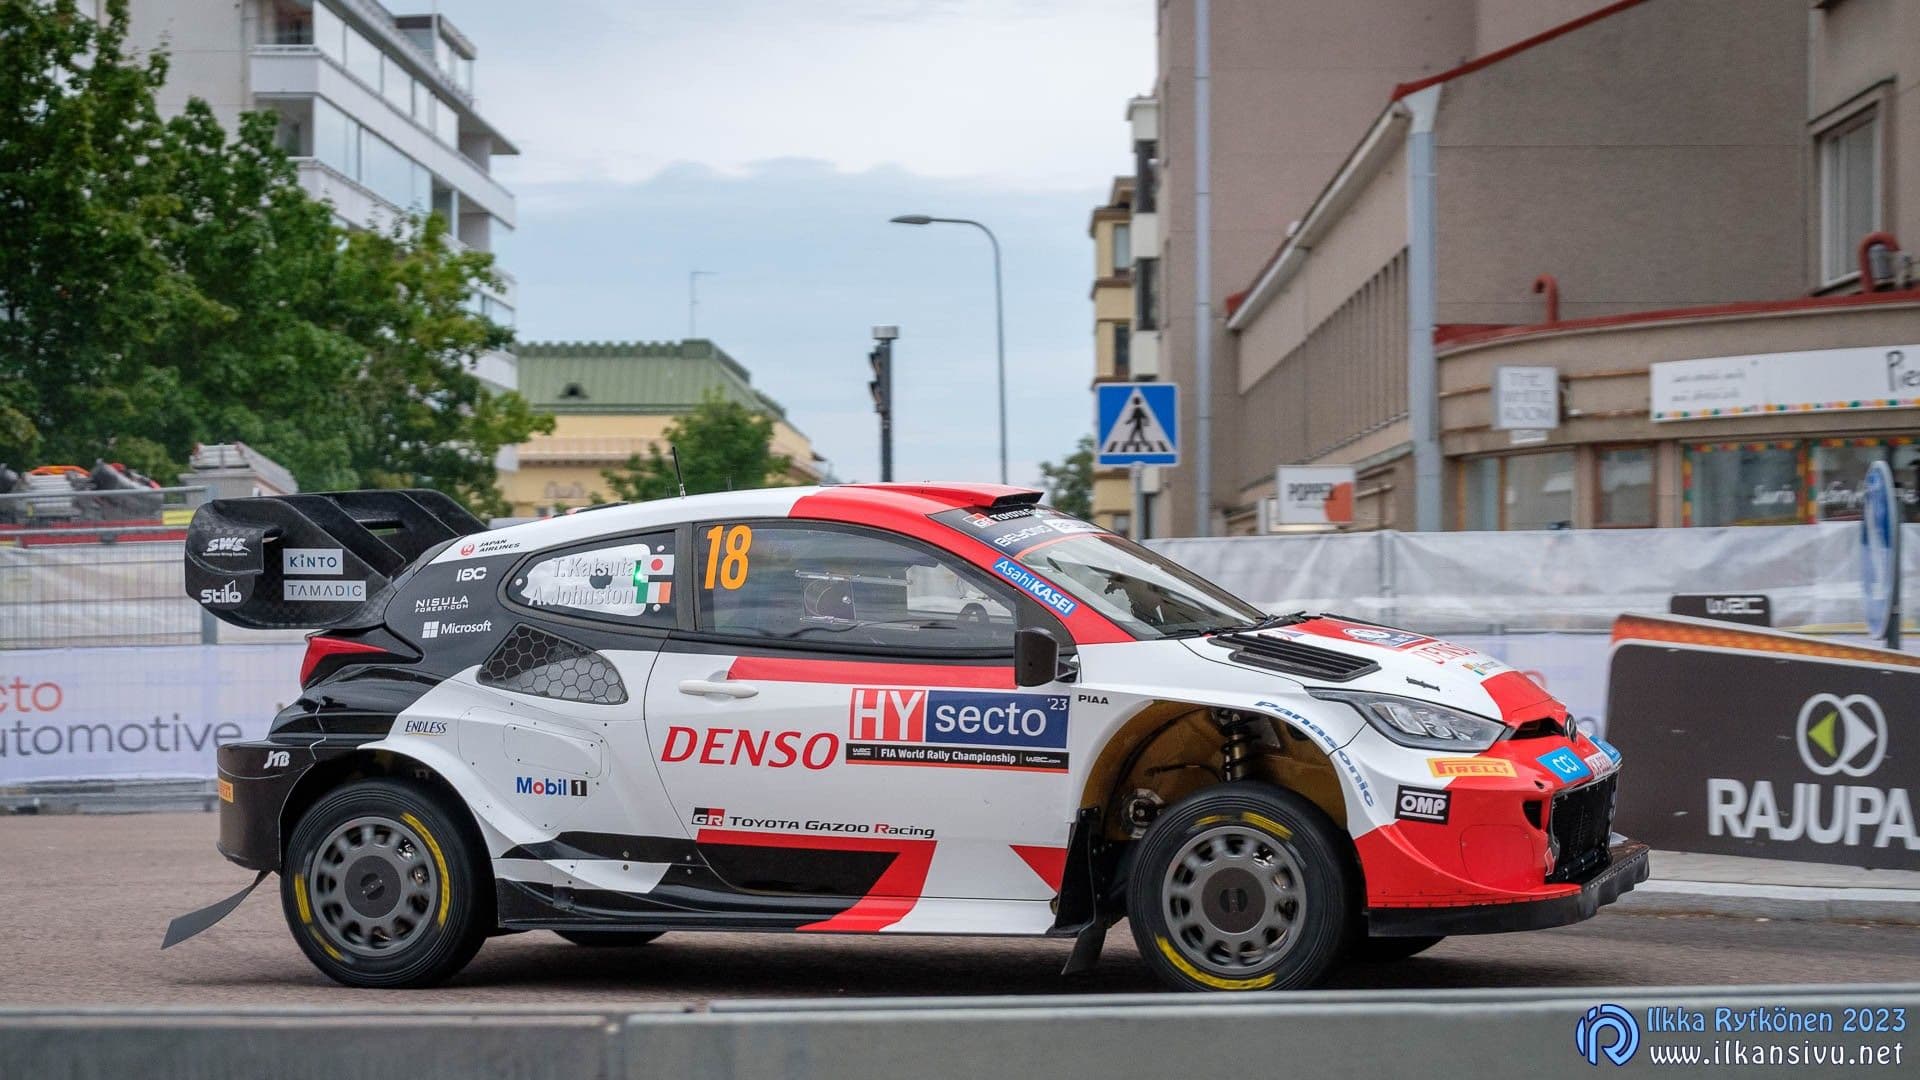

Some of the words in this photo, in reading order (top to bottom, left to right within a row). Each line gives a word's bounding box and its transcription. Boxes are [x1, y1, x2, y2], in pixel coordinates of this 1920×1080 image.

[478, 539, 507, 548] JAPAN
[478, 543, 521, 553] AIRLINES
[704, 525, 752, 590] 18
[200, 579, 242, 603] Stilo
[415, 595, 469, 608] NISULA
[440, 620, 493, 635] Microsoft
[0, 676, 64, 713] to
[1078, 694, 1109, 705] PIAA
[853, 689, 924, 741] HY
[935, 702, 1047, 737] secto
[405, 720, 448, 735] ENDLESS
[660, 726, 840, 771] DENSO
[880, 748, 896, 758] FIA
[899, 749, 925, 760] World
[927, 750, 950, 763] Rally
[952, 751, 1016, 765] Championship
[1434, 761, 1509, 775] PIRELLI
[516, 776, 567, 796] Mobil
[1400, 795, 1447, 815] OMP
